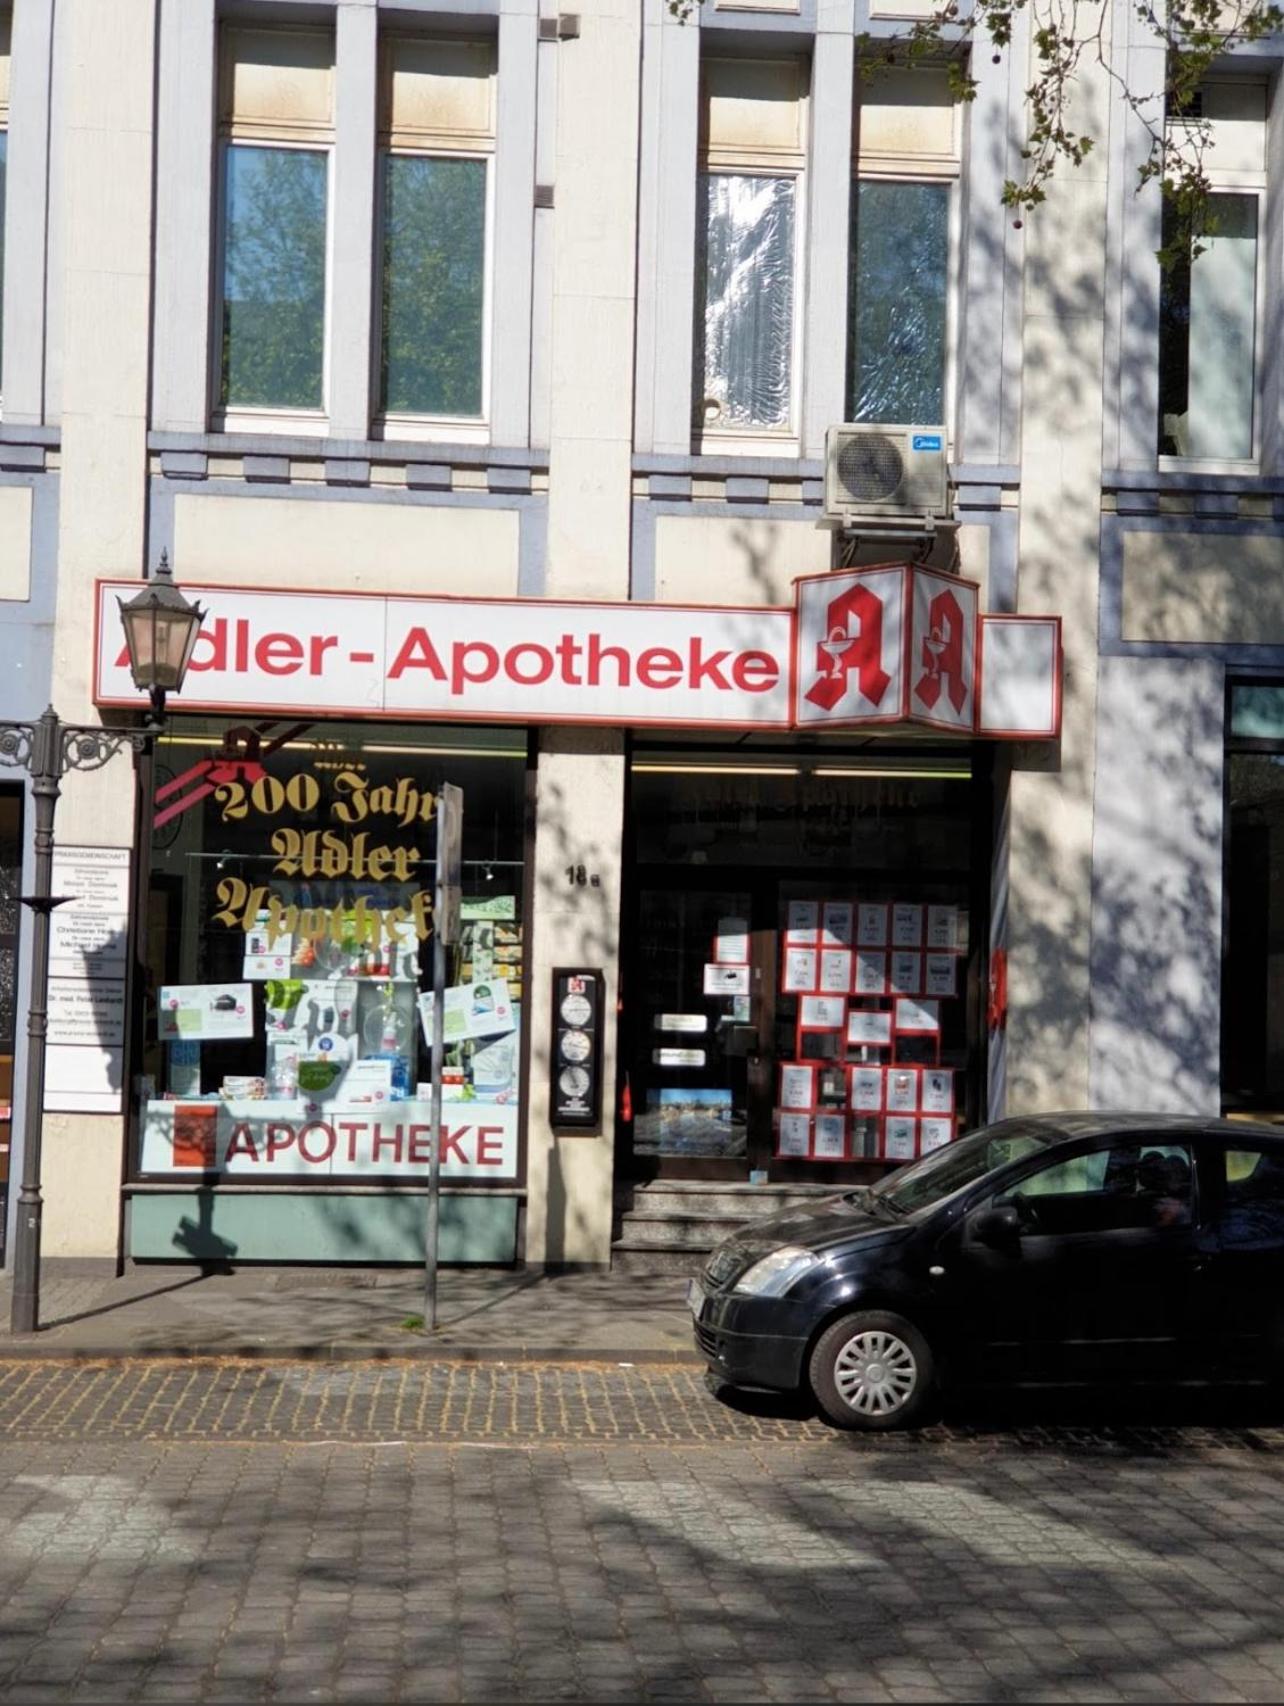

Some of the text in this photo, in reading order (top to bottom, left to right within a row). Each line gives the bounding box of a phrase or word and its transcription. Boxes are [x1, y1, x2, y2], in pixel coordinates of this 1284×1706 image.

[215, 771, 438, 828] 200 Jahr
[271, 828, 421, 882] Adler
[212, 877, 438, 954] Apothek
[225, 1121, 504, 1166] APOTHEKE
